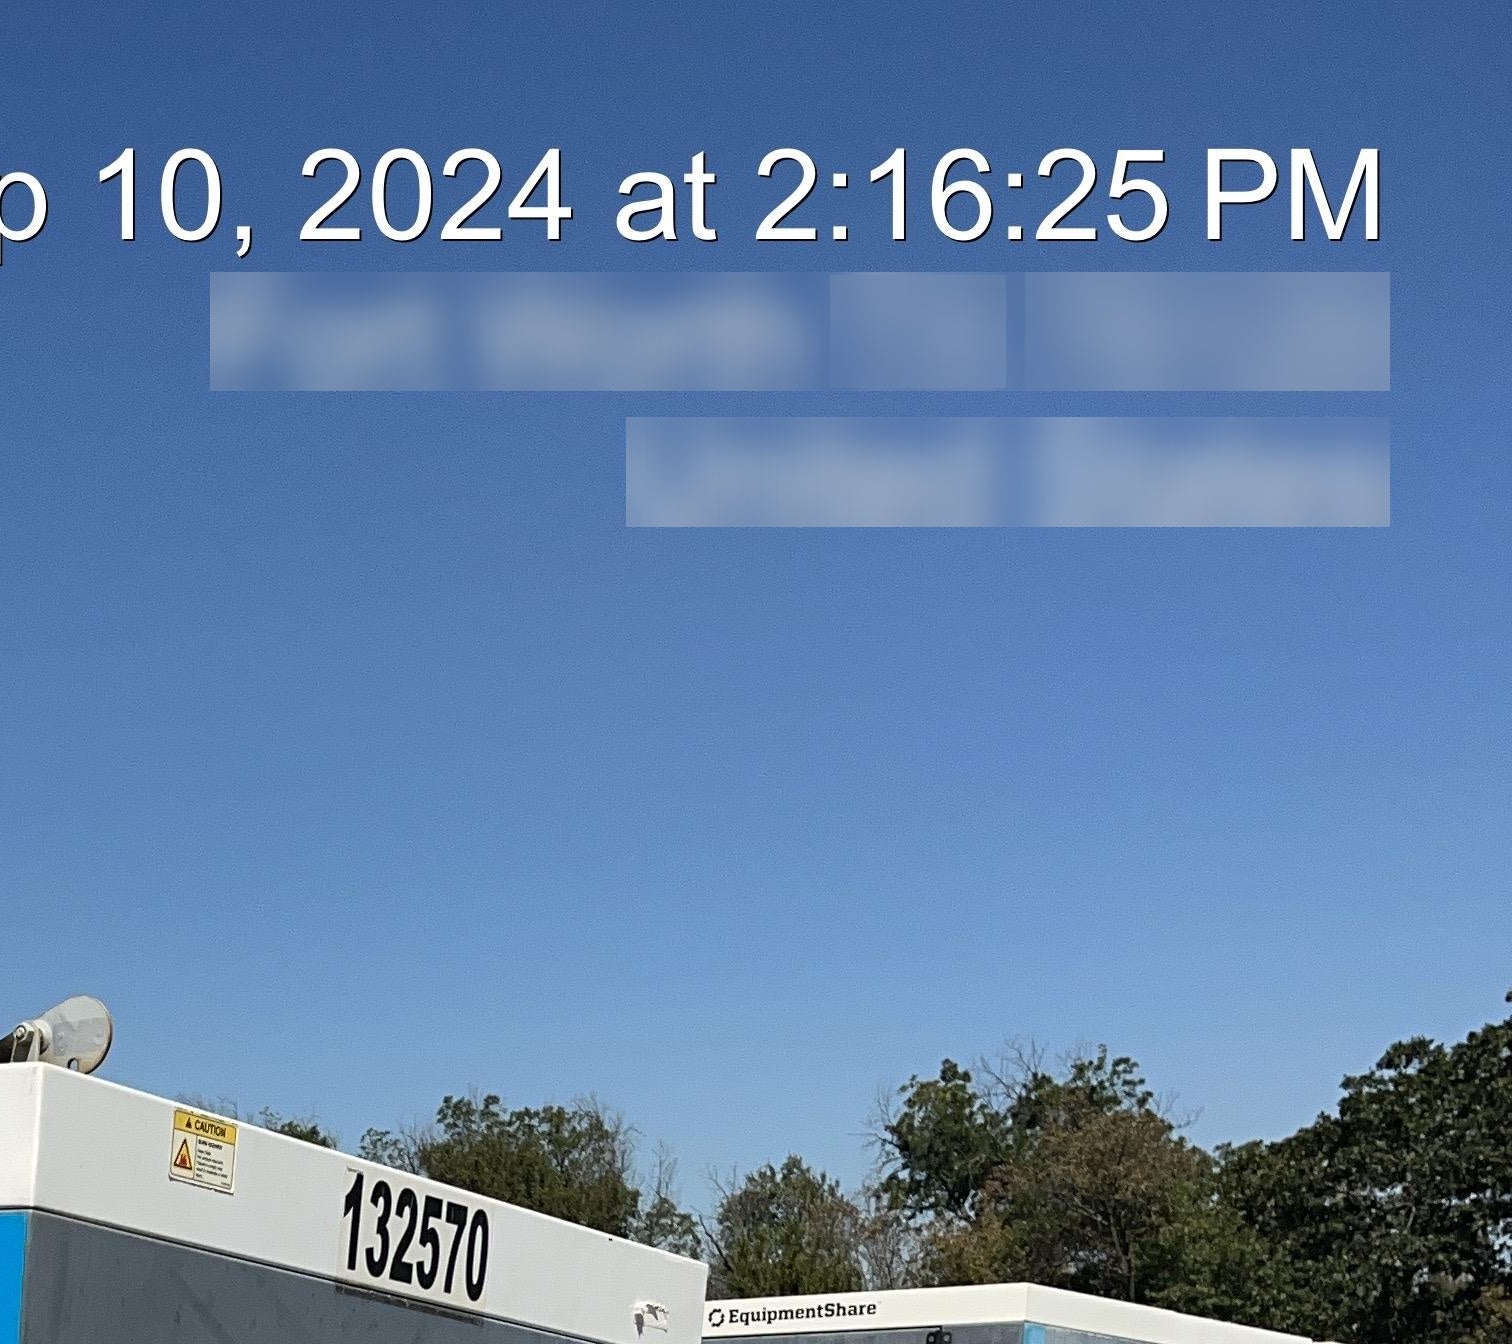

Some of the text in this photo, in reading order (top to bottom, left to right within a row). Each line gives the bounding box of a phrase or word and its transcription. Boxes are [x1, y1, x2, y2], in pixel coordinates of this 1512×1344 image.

[194, 1119, 227, 1138] CAUTION
[343, 1172, 489, 1302] 132570
[728, 1303, 877, 1326] EquipmentShare
